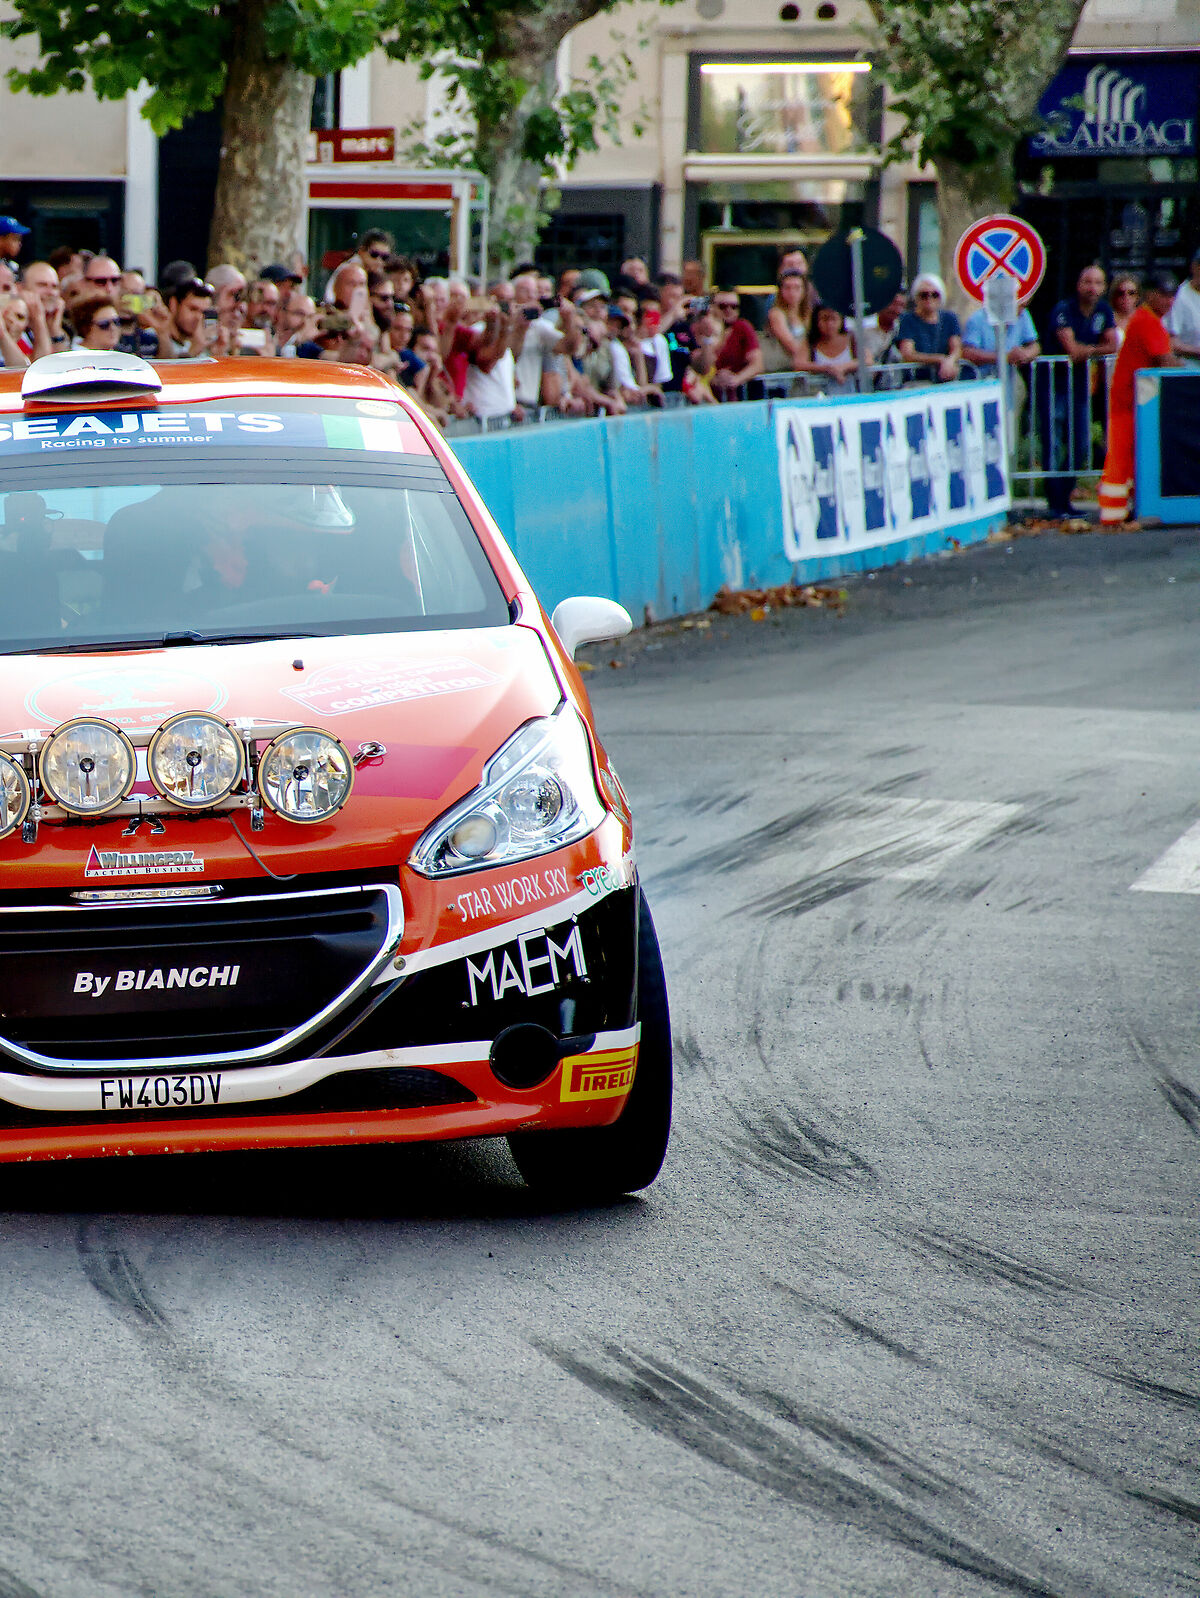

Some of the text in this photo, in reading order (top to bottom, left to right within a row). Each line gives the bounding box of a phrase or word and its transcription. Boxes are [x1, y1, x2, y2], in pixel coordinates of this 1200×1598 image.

[41, 434, 214, 449] Racing to summer
[330, 675, 484, 710] COMPETITOR
[86, 865, 204, 877] FACTUAL BUSINESS
[457, 866, 570, 922] STAR WORK SKY
[73, 965, 240, 997] By BIANCHI
[100, 1074, 222, 1109] FW403DV
